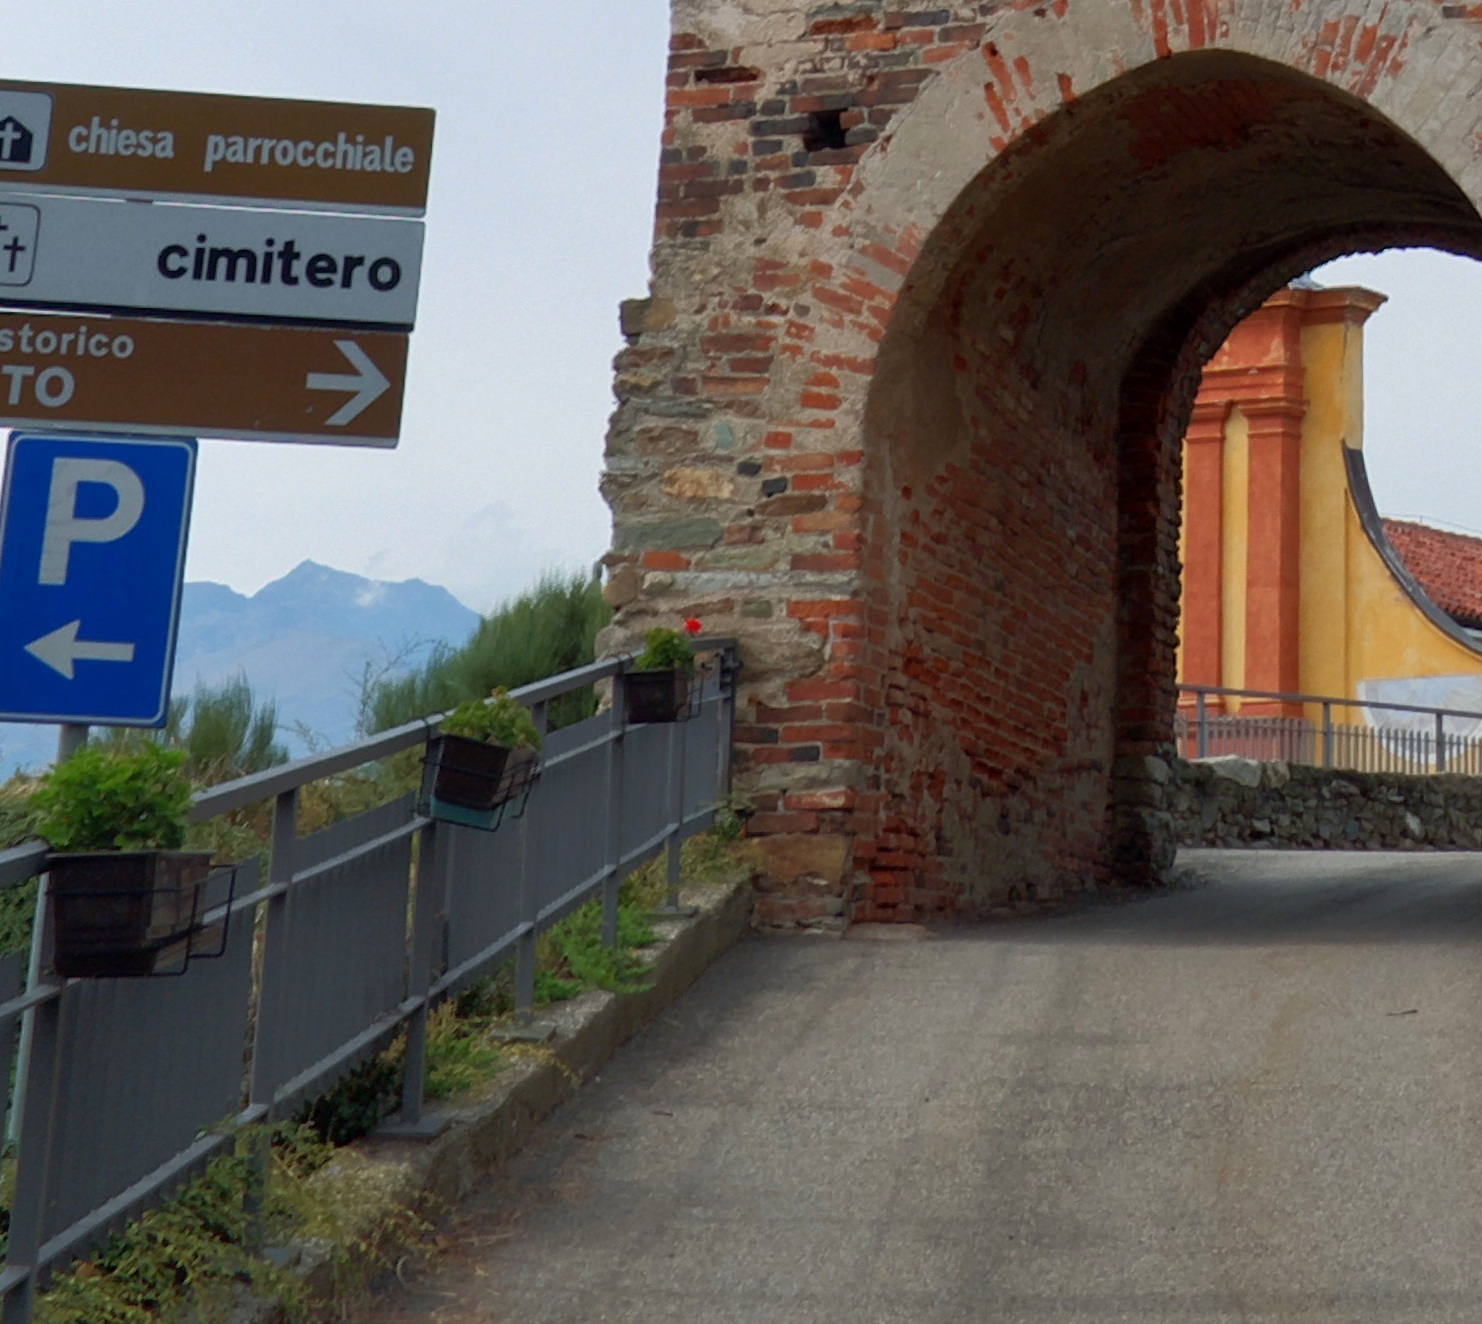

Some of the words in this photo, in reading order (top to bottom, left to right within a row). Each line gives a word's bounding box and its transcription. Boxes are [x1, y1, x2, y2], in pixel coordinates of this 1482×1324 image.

[68, 116, 175, 159] chiesa
[204, 131, 415, 174] parrocchiale
[157, 233, 402, 292] cimitero
[0, 323, 135, 360] storico
[37, 457, 145, 586] P
